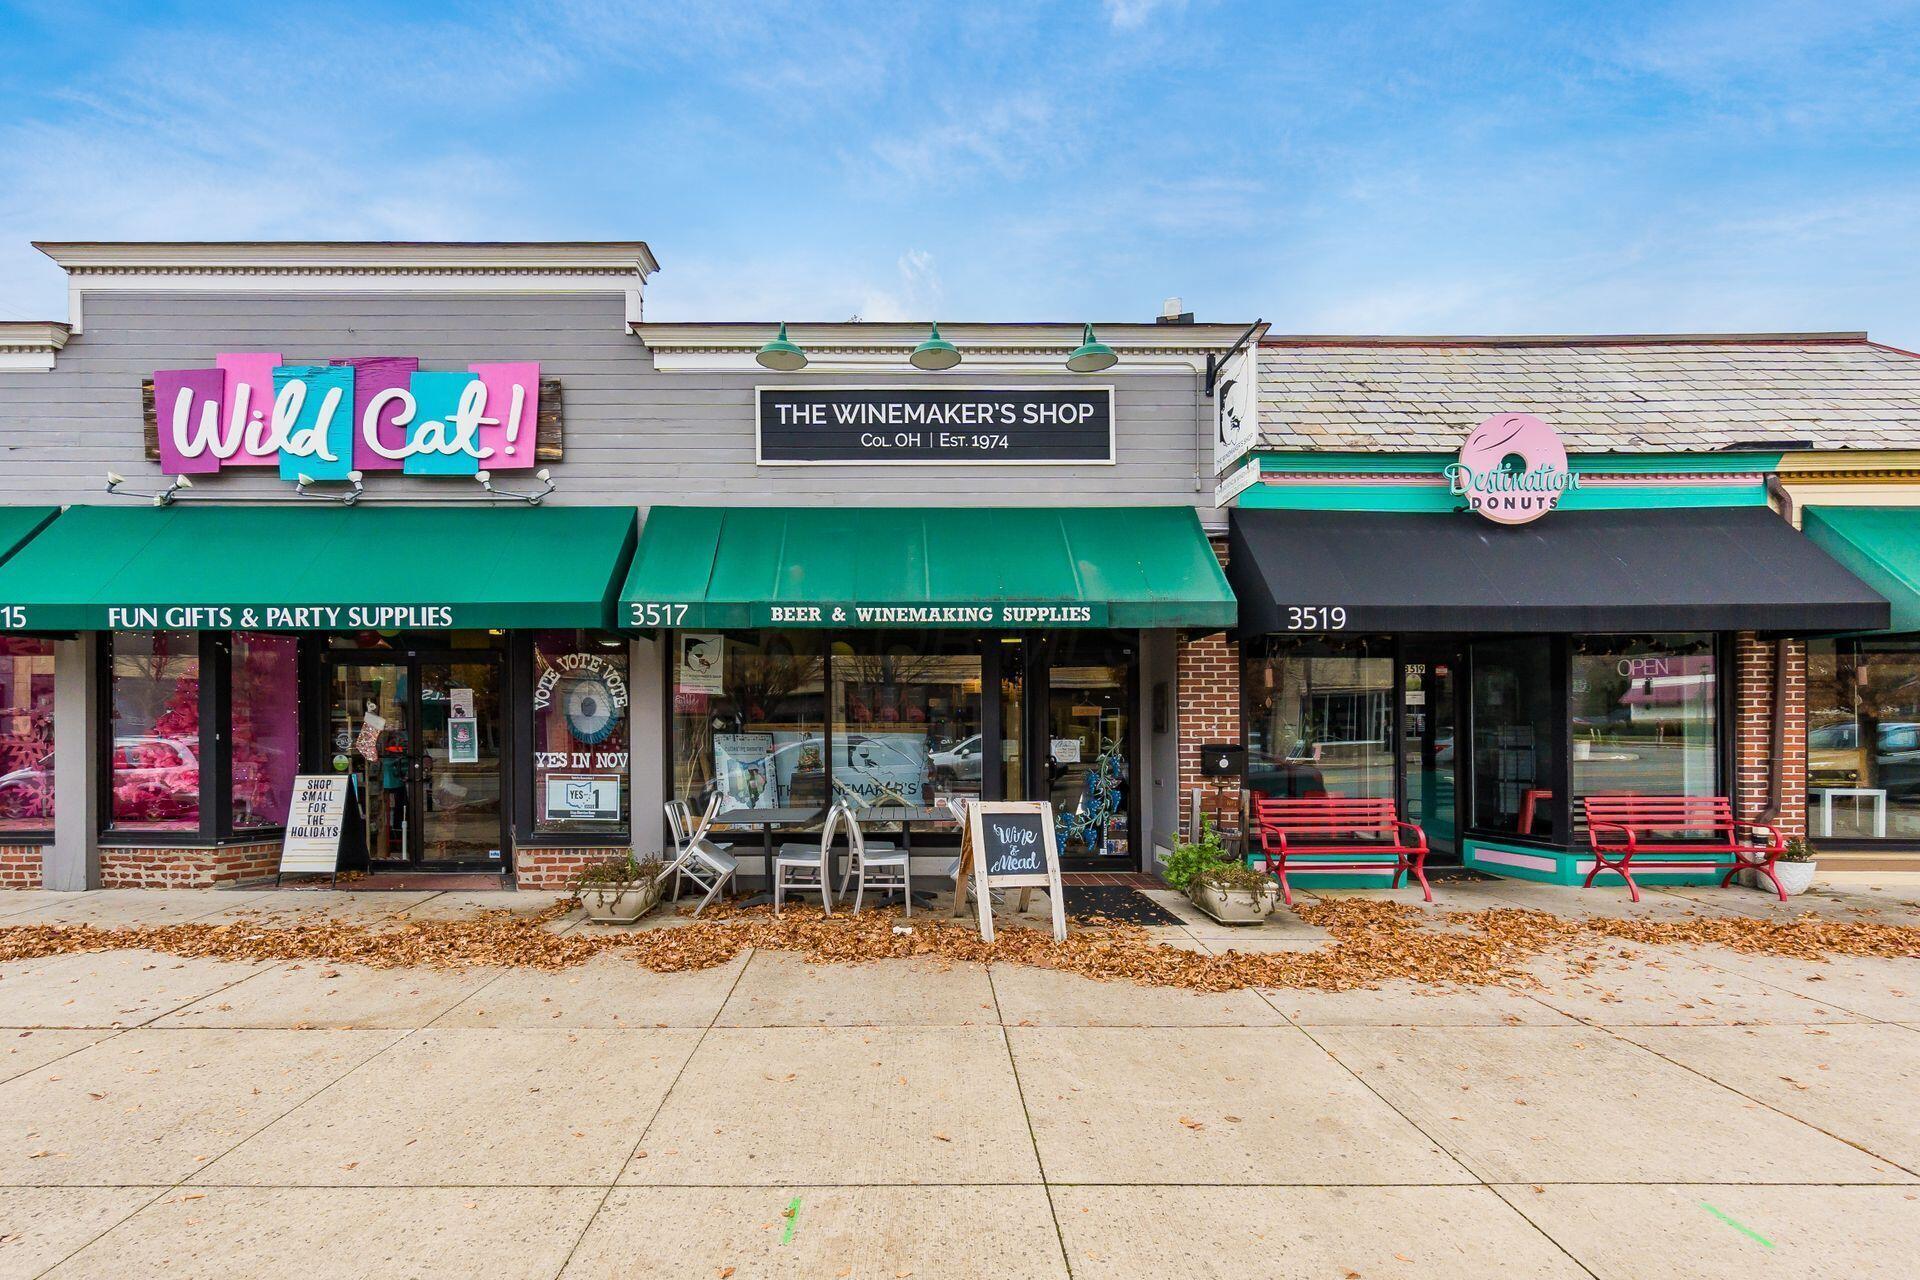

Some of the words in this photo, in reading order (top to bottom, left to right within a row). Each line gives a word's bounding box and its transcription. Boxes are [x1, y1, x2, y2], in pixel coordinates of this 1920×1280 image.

[172, 379, 344, 461] Wild
[363, 379, 525, 459] Cat!
[775, 404, 827, 425] THE
[832, 403, 1017, 425] WINEMAKER'S
[1023, 403, 1095, 424] SHOP
[895, 433, 921, 447] OH
[971, 434, 1009, 449] 1974
[1443, 462, 1582, 495] Destination
[1471, 496, 1559, 509] DONUTS
[108, 607, 158, 627] FUN
[165, 606, 232, 628] GIFTS
[240, 606, 260, 628] &
[266, 606, 341, 627] PARTY
[348, 606, 453, 627] SUPPLIES
[630, 603, 689, 626] 3517
[770, 606, 822, 622] BEER
[831, 606, 846, 622] &
[855, 606, 993, 622] WINEMAKING
[1003, 606, 1091, 622] SUPPLIES
[1287, 606, 1347, 630] 3519
[1617, 658, 1669, 677] OPEN
[534, 666, 561, 711] VOTE
[556, 653, 603, 673] VOTE
[603, 664, 628, 709] VOTE
[535, 752, 567, 768] YES
[571, 752, 591, 768] IN
[596, 752, 629, 768] NOV
[307, 779, 332, 790] SHOP
[302, 791, 334, 802] SMALL
[570, 790, 584, 800] YES
[592, 789, 600, 809] 1
[308, 803, 327, 813] FOR
[307, 814, 325, 825] THE
[291, 826, 339, 838] HOLIDAYS
[993, 823, 1038, 846] Wine
[1009, 844, 1020, 856] &
[990, 851, 1041, 873] Mead
